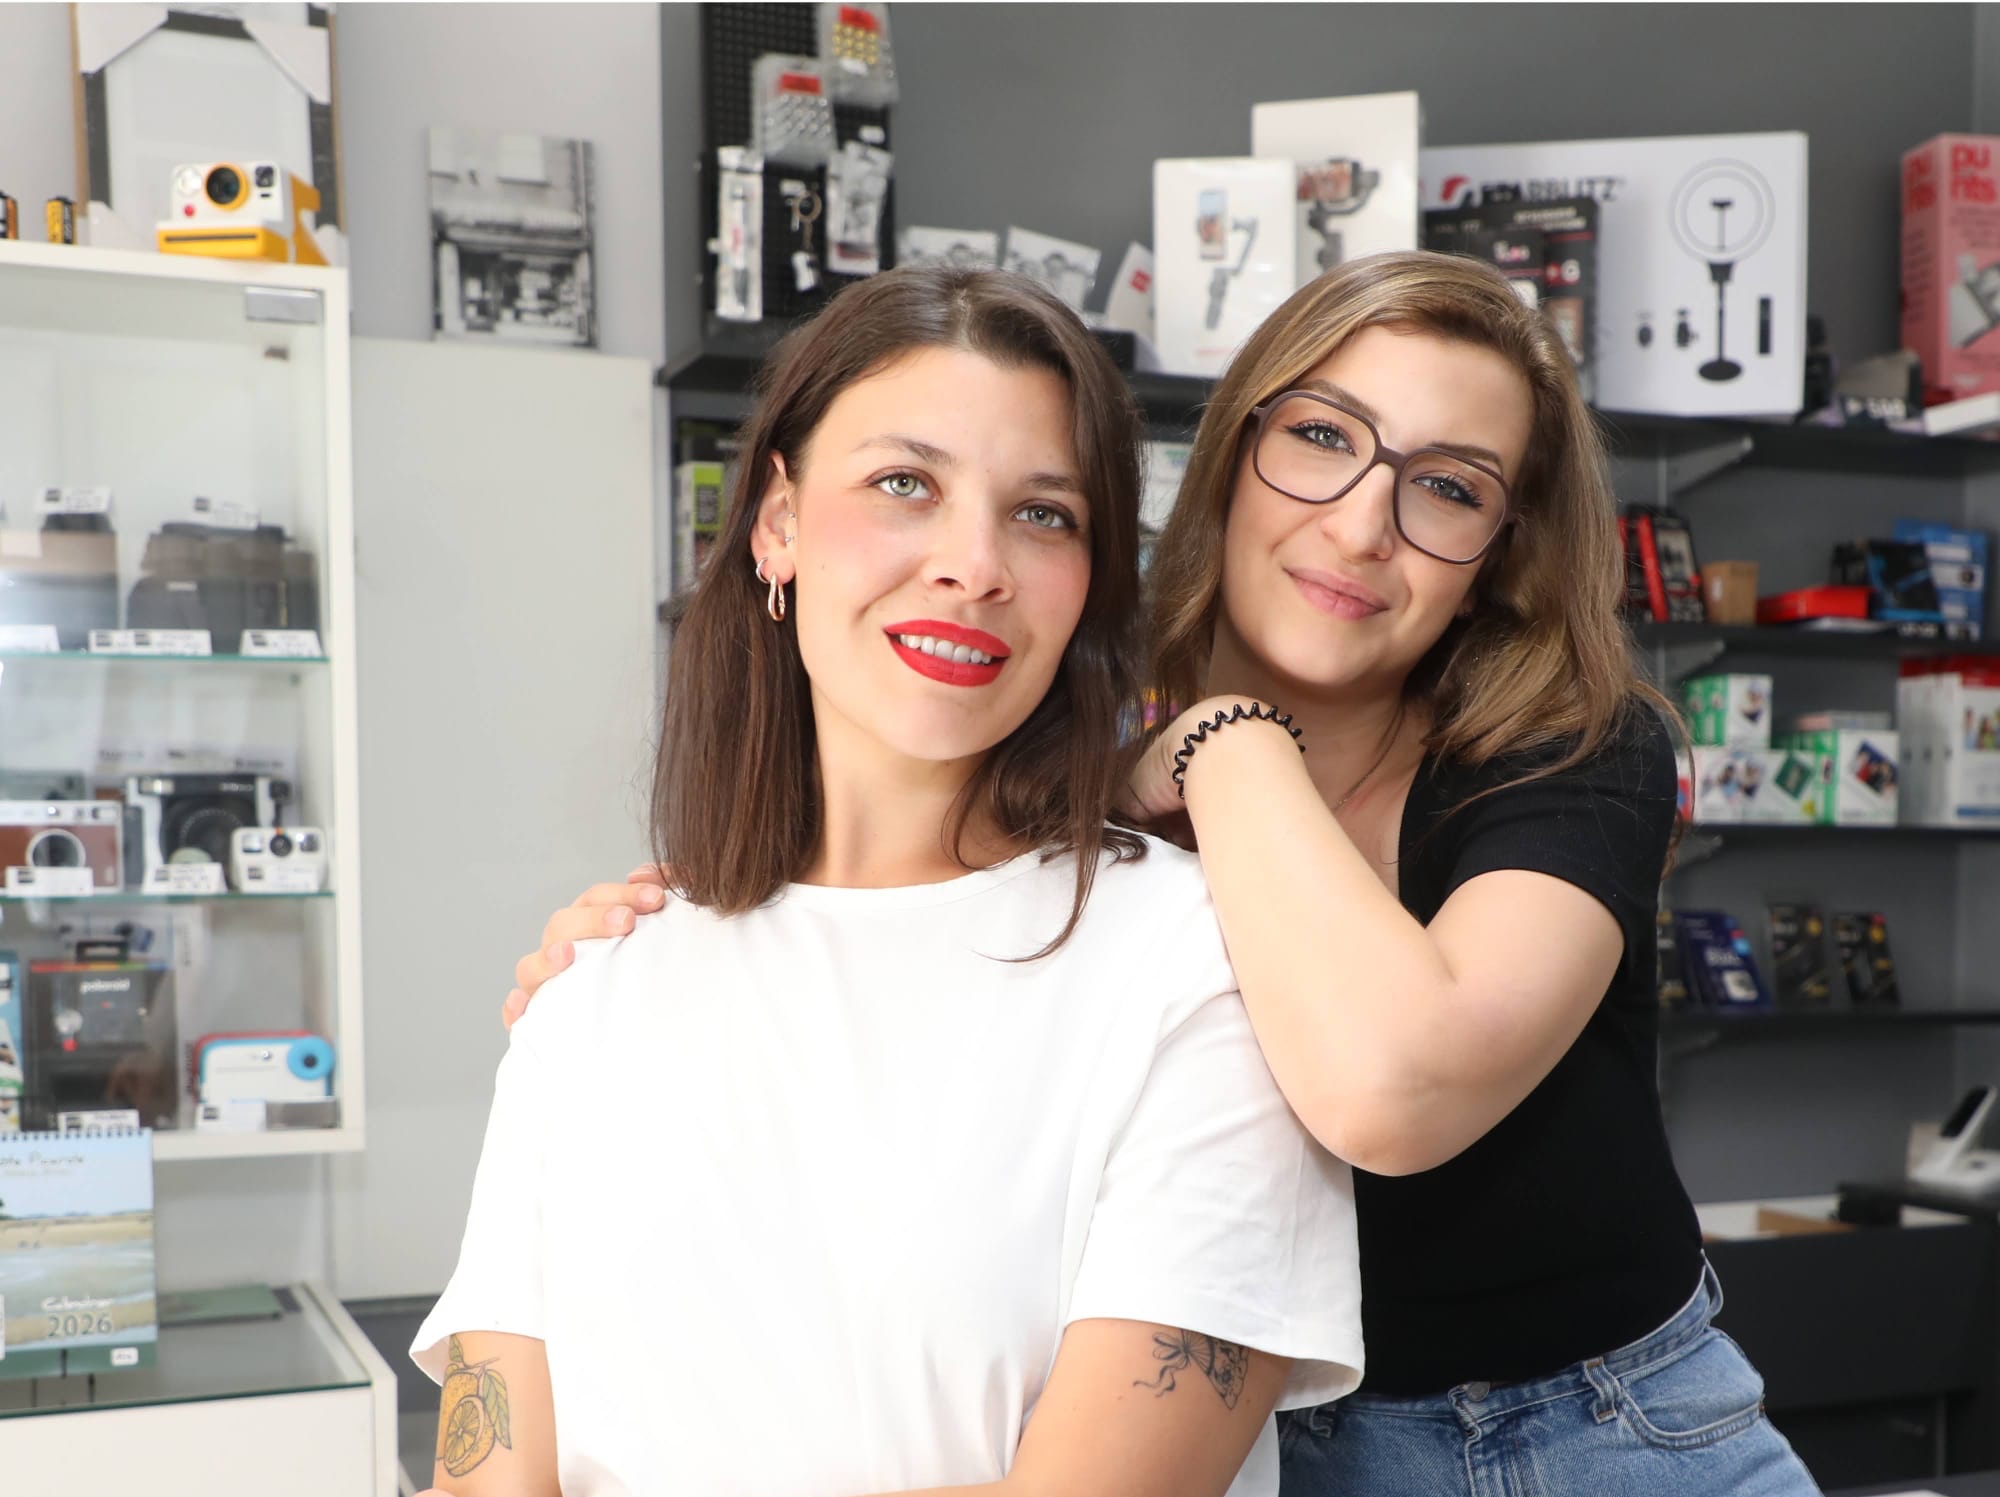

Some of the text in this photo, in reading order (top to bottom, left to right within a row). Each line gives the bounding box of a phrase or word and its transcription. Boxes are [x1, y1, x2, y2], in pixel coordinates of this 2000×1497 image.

[1481, 175, 1617, 203] ARBLITZ
[80, 977, 130, 995] polaroid
[47, 1310, 112, 1338] 2026
